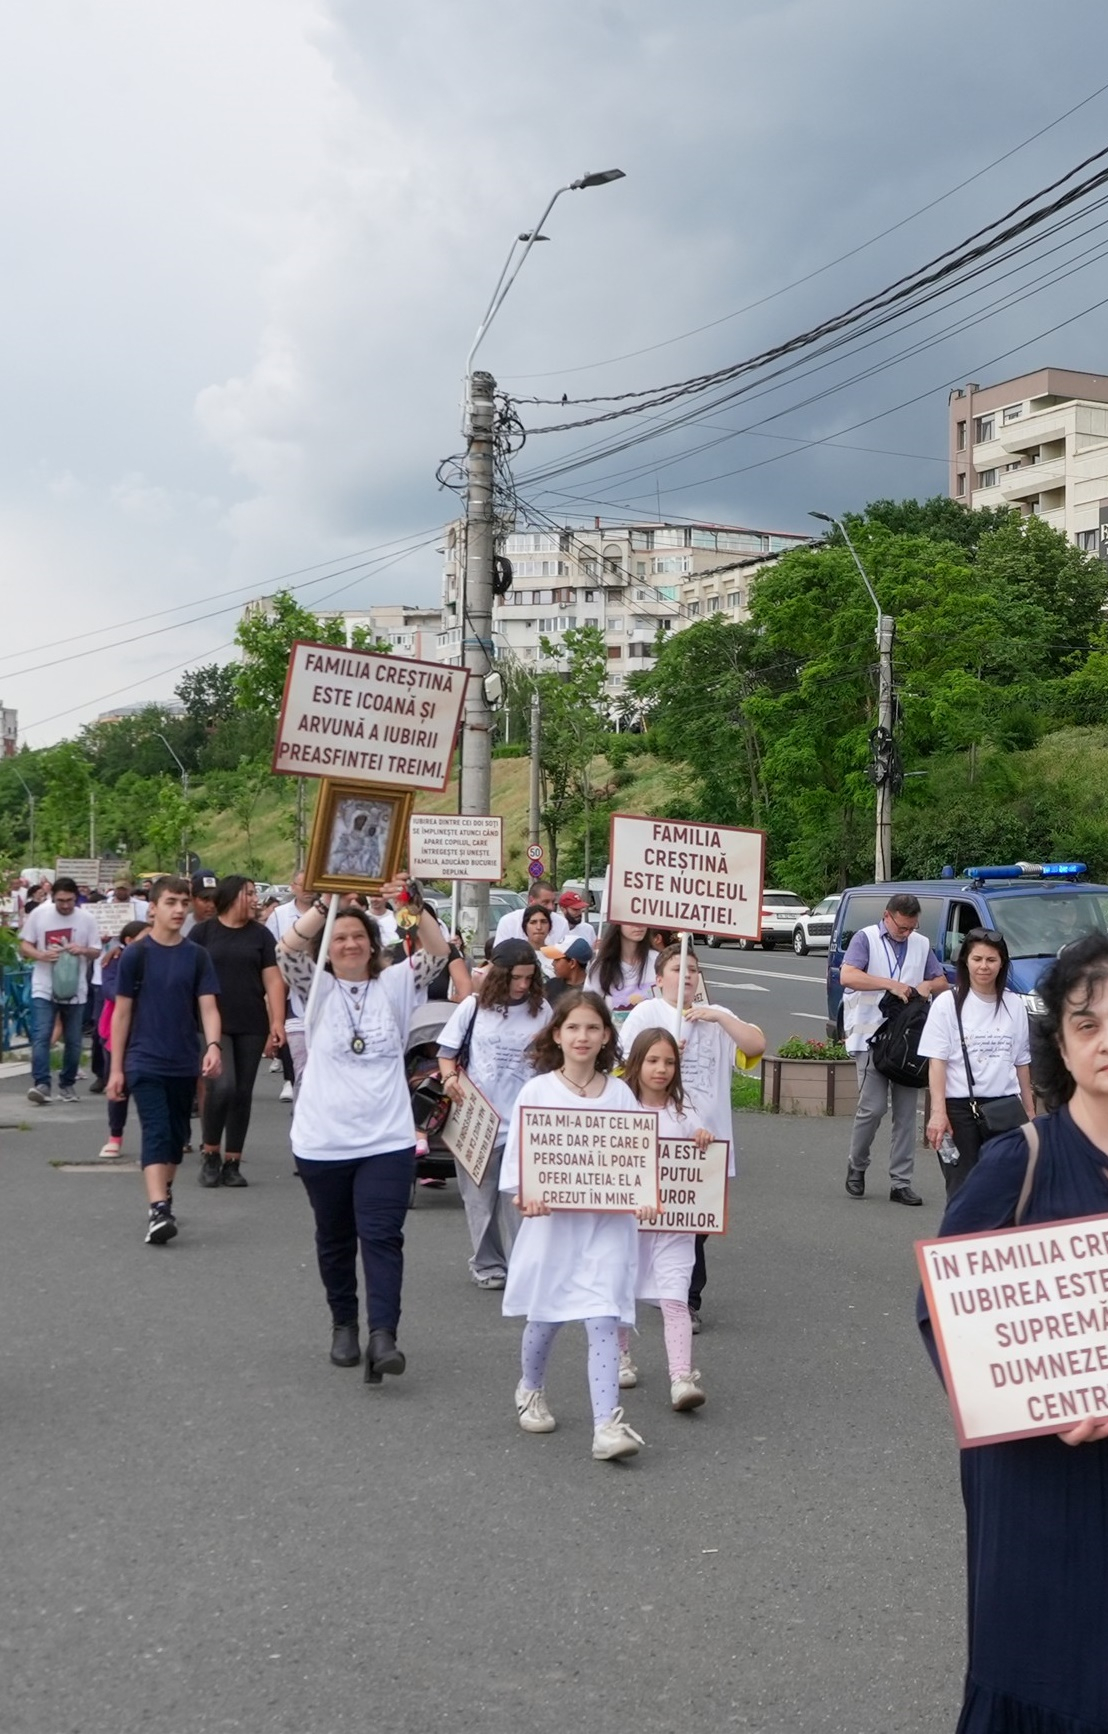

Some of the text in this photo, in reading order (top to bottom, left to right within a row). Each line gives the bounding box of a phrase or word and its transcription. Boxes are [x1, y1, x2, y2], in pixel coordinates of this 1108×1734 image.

[305, 654, 454, 693] FAMILIA CREȘTINĂ
[312, 685, 436, 724] ESTE ICOANĂ ȘI
[298, 714, 438, 749] ARVUNĂ A IUBIRII
[278, 742, 445, 780] PREASFINTEI TREIMI.
[421, 827, 458, 837] ÎMPLINEȘTE
[482, 829, 499, 837] CÂND
[653, 824, 721, 849] FAMILIA
[421, 847, 458, 856] ÎNTREGEȘTE
[423, 838, 443, 846] APARE
[444, 839, 471, 847] COPILUL,
[529, 847, 541, 858] 50
[644, 848, 729, 875] CREȘTINĂ
[413, 858, 440, 866] FAMILIA,
[441, 858, 470, 866] ADUCÂND
[623, 870, 748, 902] ESTE NUCLEUL
[630, 896, 737, 928] CIVILIZAȚIEI.
[525, 1113, 654, 1131] TATA MI-A DAT CEL MAI
[530, 1133, 650, 1150] MARE DAR PE CARE O
[533, 1150, 646, 1168] PERSOANĂ ÎL POATE
[658, 1143, 670, 1159] IA
[538, 1171, 642, 1187] OFERI ALTEIA: EL A
[660, 1166, 704, 1183] PUTUL
[542, 1188, 639, 1205] CREZUT ÎN MINE.
[659, 1188, 696, 1205] UROR
[929, 1250, 961, 1281] ÎN
[966, 1239, 1066, 1276] FAMILIA
[950, 1279, 1051, 1316] IUBIREA
